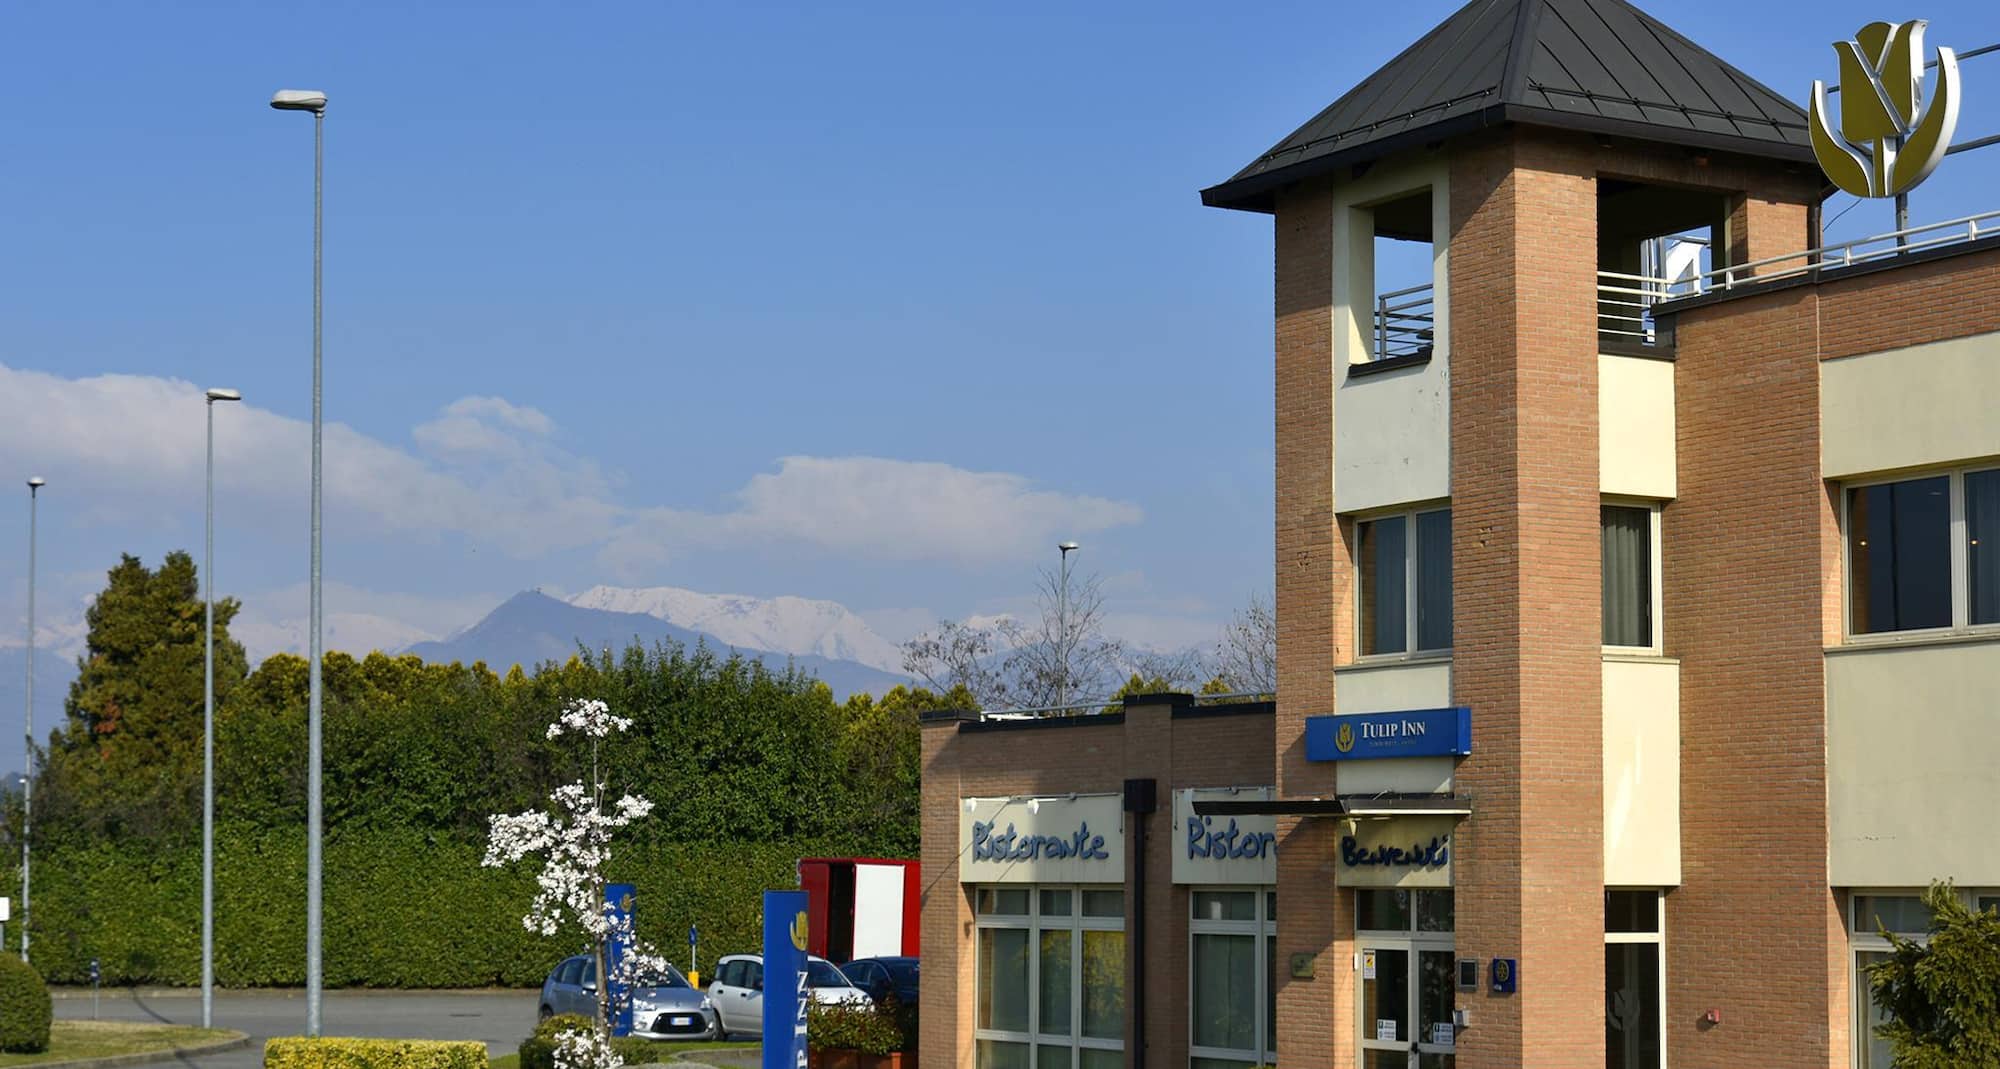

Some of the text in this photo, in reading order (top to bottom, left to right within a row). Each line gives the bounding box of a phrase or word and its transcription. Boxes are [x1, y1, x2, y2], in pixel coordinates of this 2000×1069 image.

[1361, 720, 1425, 738] TULIP INN
[971, 821, 1109, 863] Ristorante
[1187, 815, 1277, 860] Ristor
[1342, 834, 1449, 867] Benvenuti
[795, 971, 808, 1036] INN
